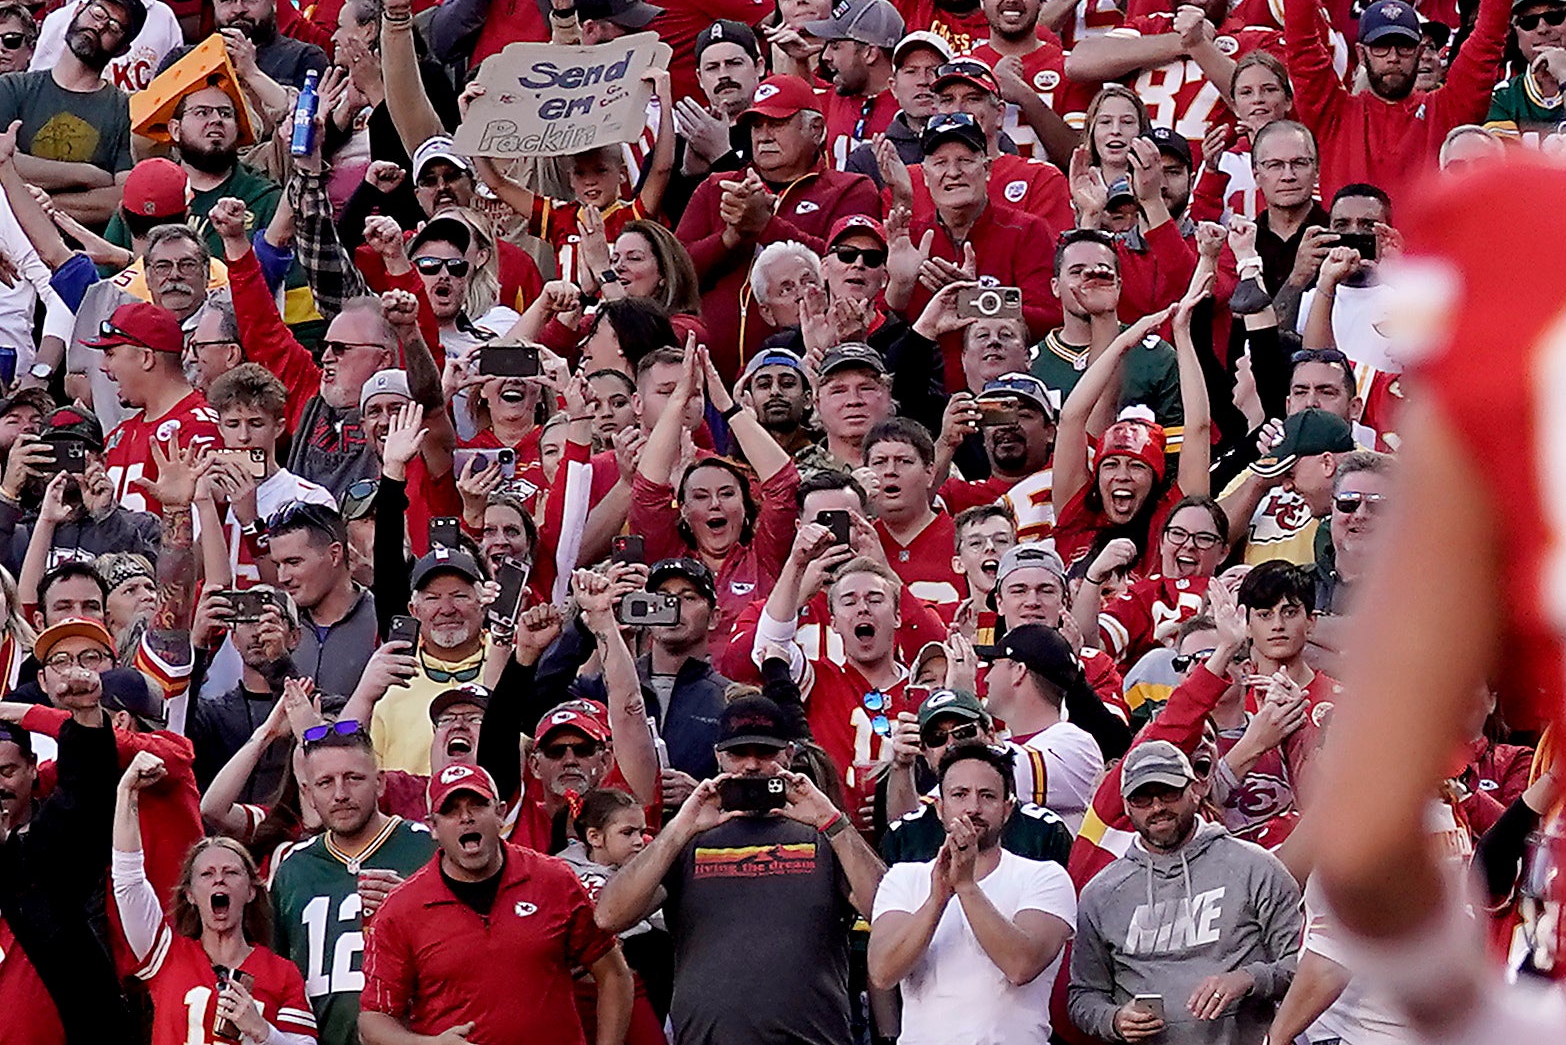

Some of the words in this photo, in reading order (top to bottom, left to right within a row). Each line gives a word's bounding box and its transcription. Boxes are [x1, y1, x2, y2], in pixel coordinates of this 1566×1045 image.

[112, 62, 152, 90] KC
[518, 49, 635, 89] Send
[535, 93, 596, 121] 'em
[1136, 59, 1211, 136] 87
[300, 896, 364, 996] 12
[1126, 886, 1226, 955] NIKE
